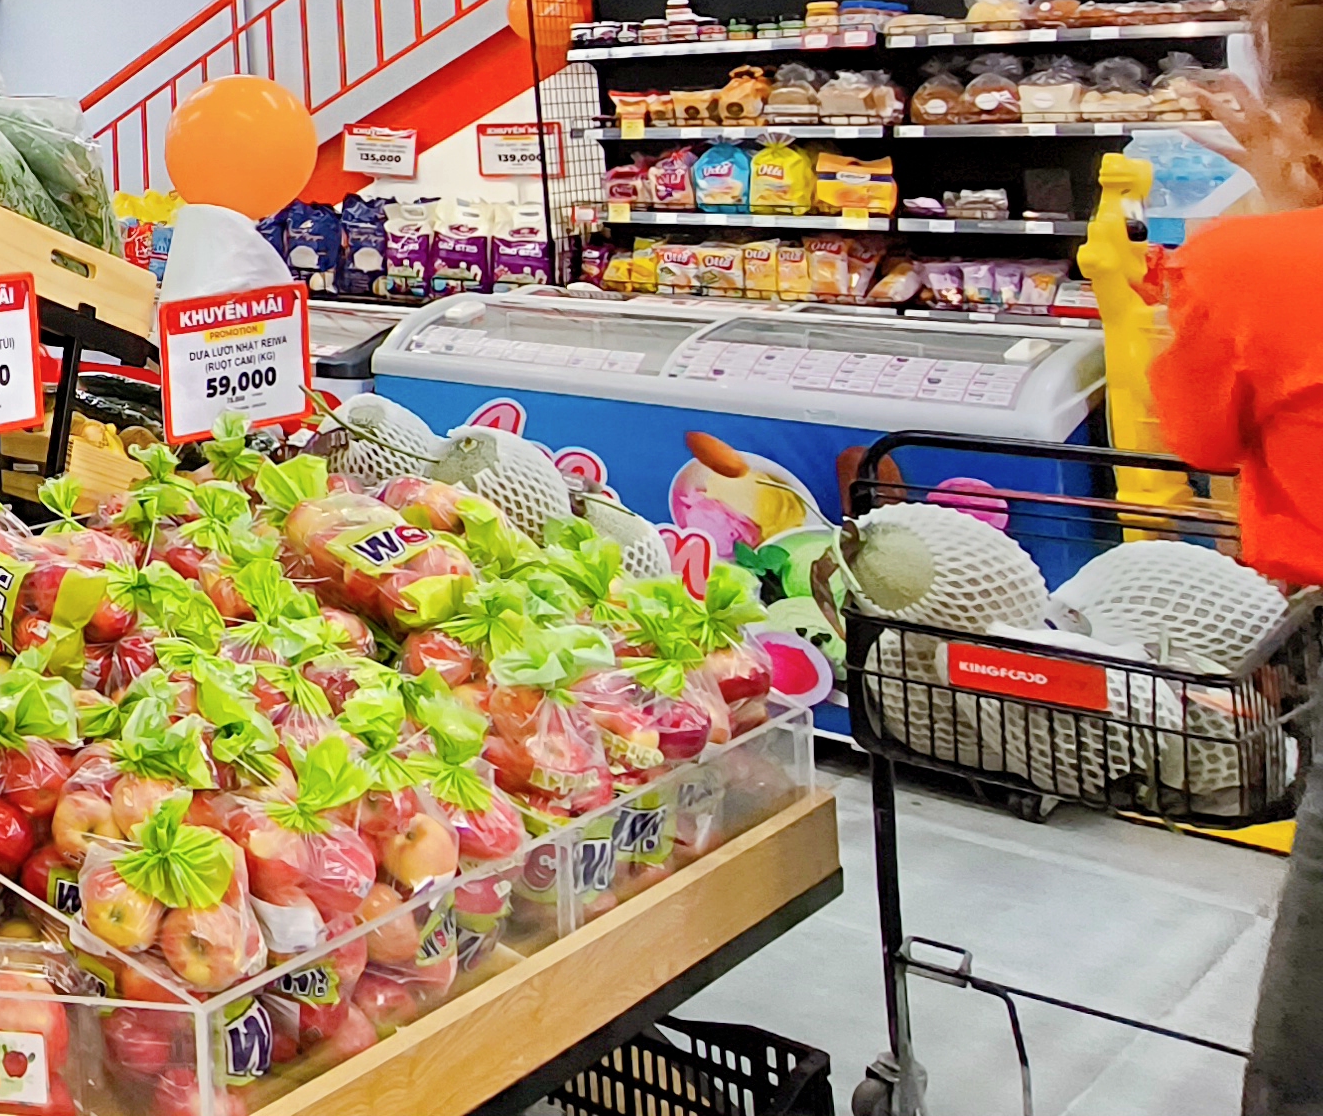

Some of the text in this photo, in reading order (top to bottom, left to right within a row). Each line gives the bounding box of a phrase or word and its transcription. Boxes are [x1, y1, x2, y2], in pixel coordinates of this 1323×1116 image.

[359, 152, 402, 164] 135,000
[179, 294, 283, 327] KHUYẾN MÃI
[209, 325, 258, 339] PROMOTION
[260, 336, 287, 348] REIWA
[258, 351, 276, 364] (KG)
[206, 366, 277, 398] 59,000
[348, 525, 435, 566] WO
[958, 660, 1048, 685] KINGFOOD
